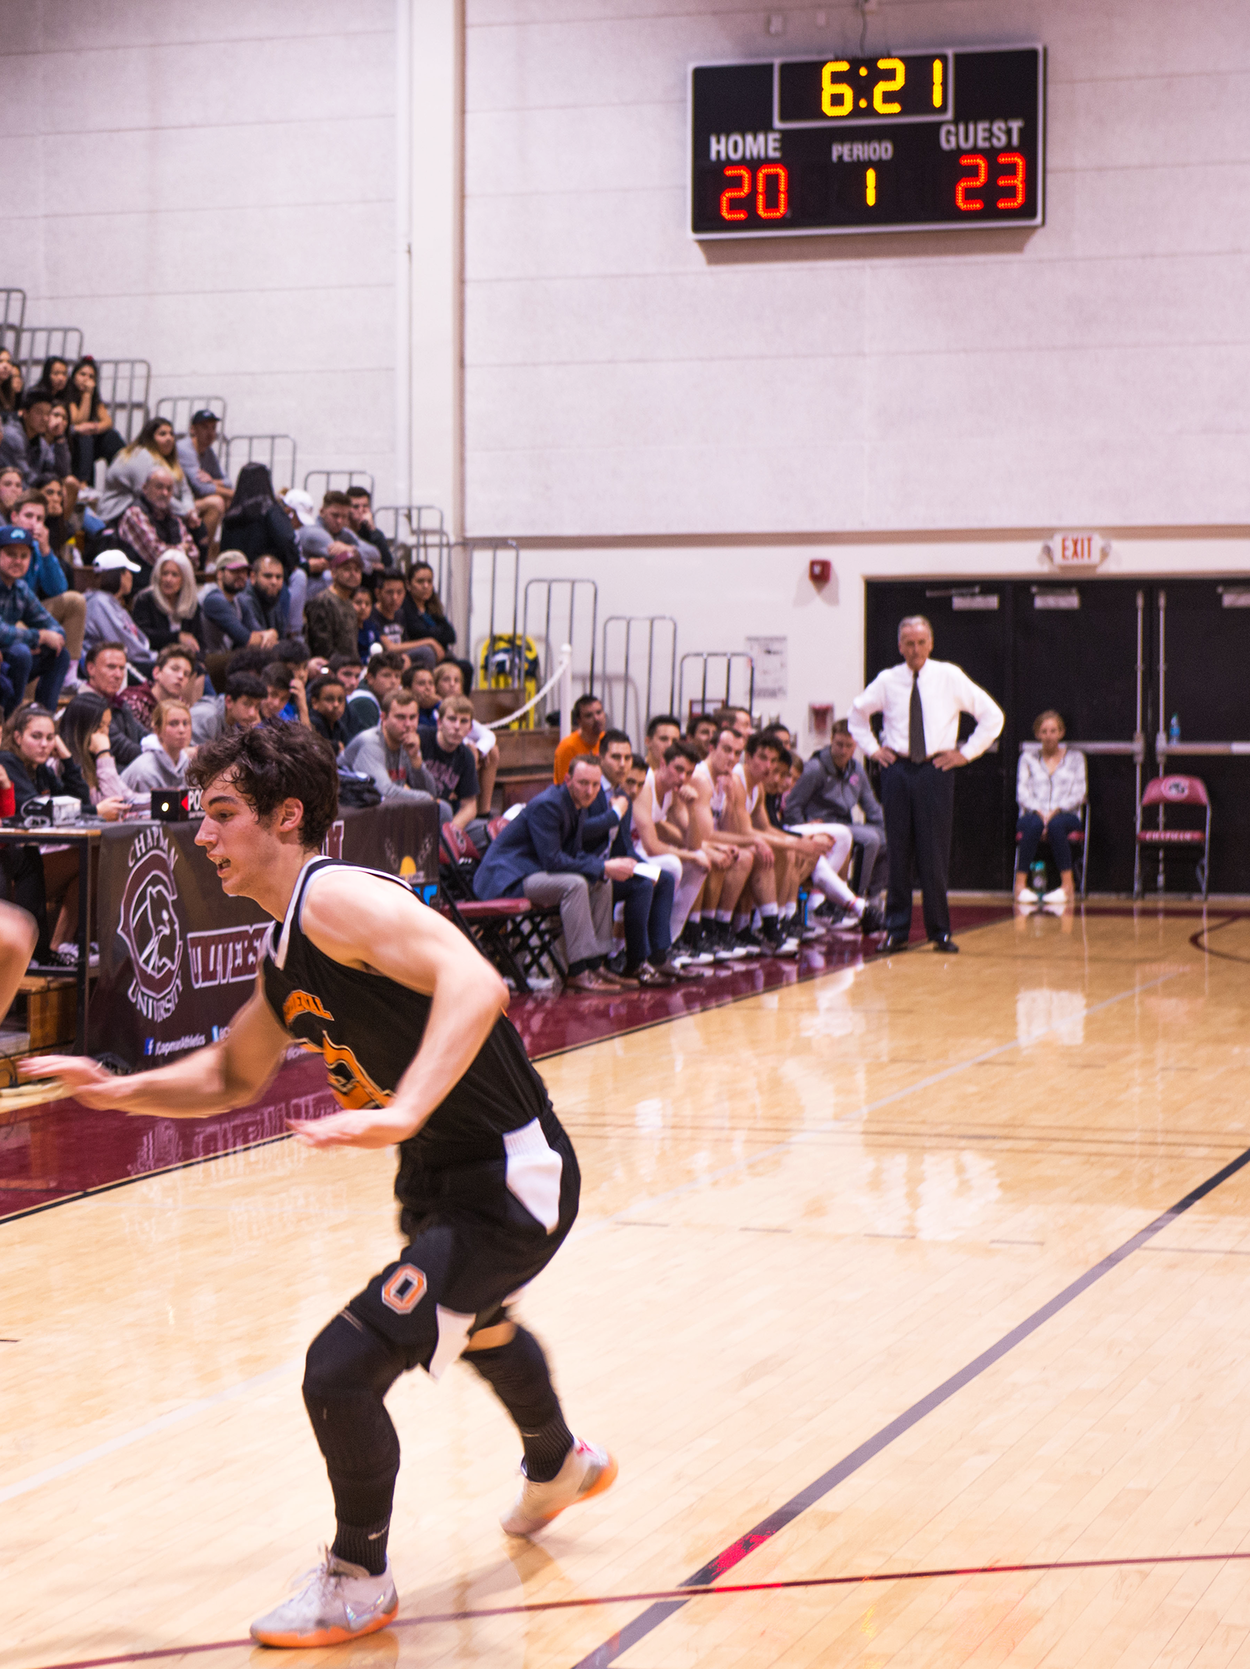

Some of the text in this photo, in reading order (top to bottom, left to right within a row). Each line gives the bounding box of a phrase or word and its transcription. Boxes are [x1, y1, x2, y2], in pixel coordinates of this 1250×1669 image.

[821, 57, 943, 116] 6:21
[709, 132, 782, 161] HOME
[939, 119, 1025, 151] GUEST
[831, 141, 894, 162] PERIOD
[720, 164, 788, 221] 20
[866, 168, 877, 207] 1
[956, 152, 1026, 211] 23
[1061, 537, 1093, 561] EXIT
[188, 789, 203, 812] PO
